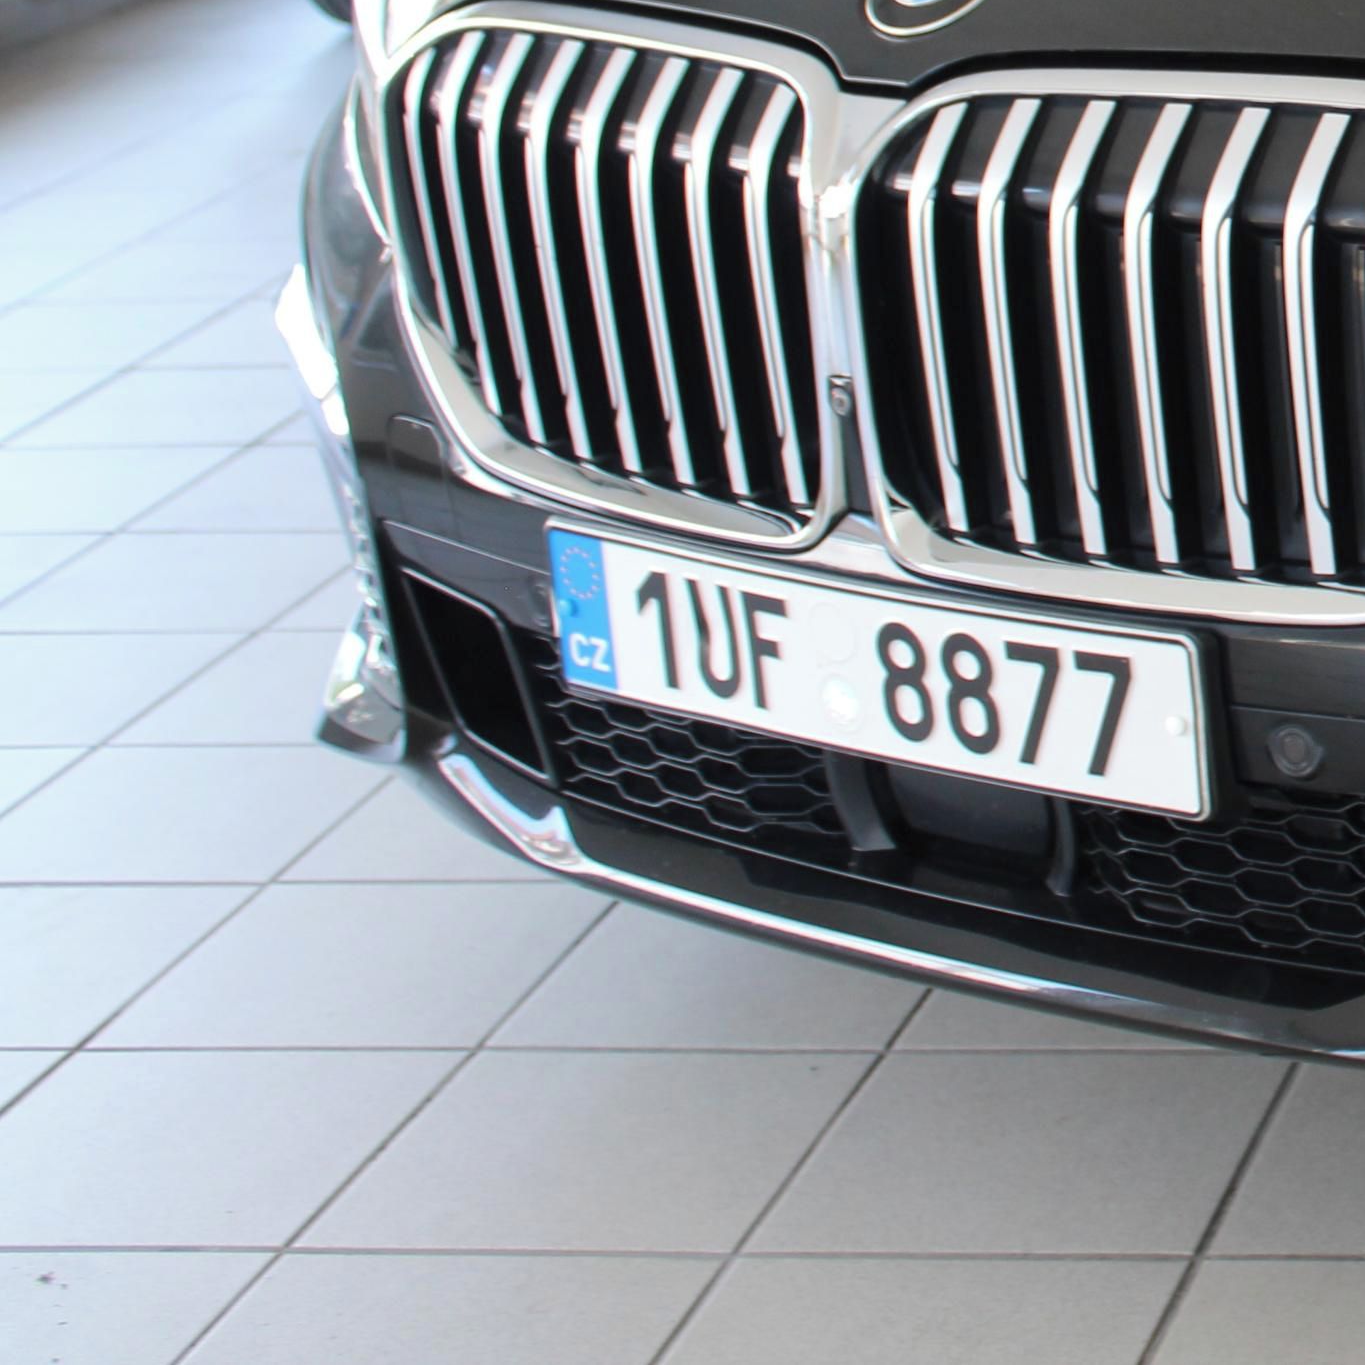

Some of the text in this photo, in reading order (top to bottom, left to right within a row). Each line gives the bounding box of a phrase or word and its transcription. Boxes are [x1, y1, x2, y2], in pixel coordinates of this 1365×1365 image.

[570, 632, 612, 674] CZ
[637, 571, 1132, 778] 1UF 8877
